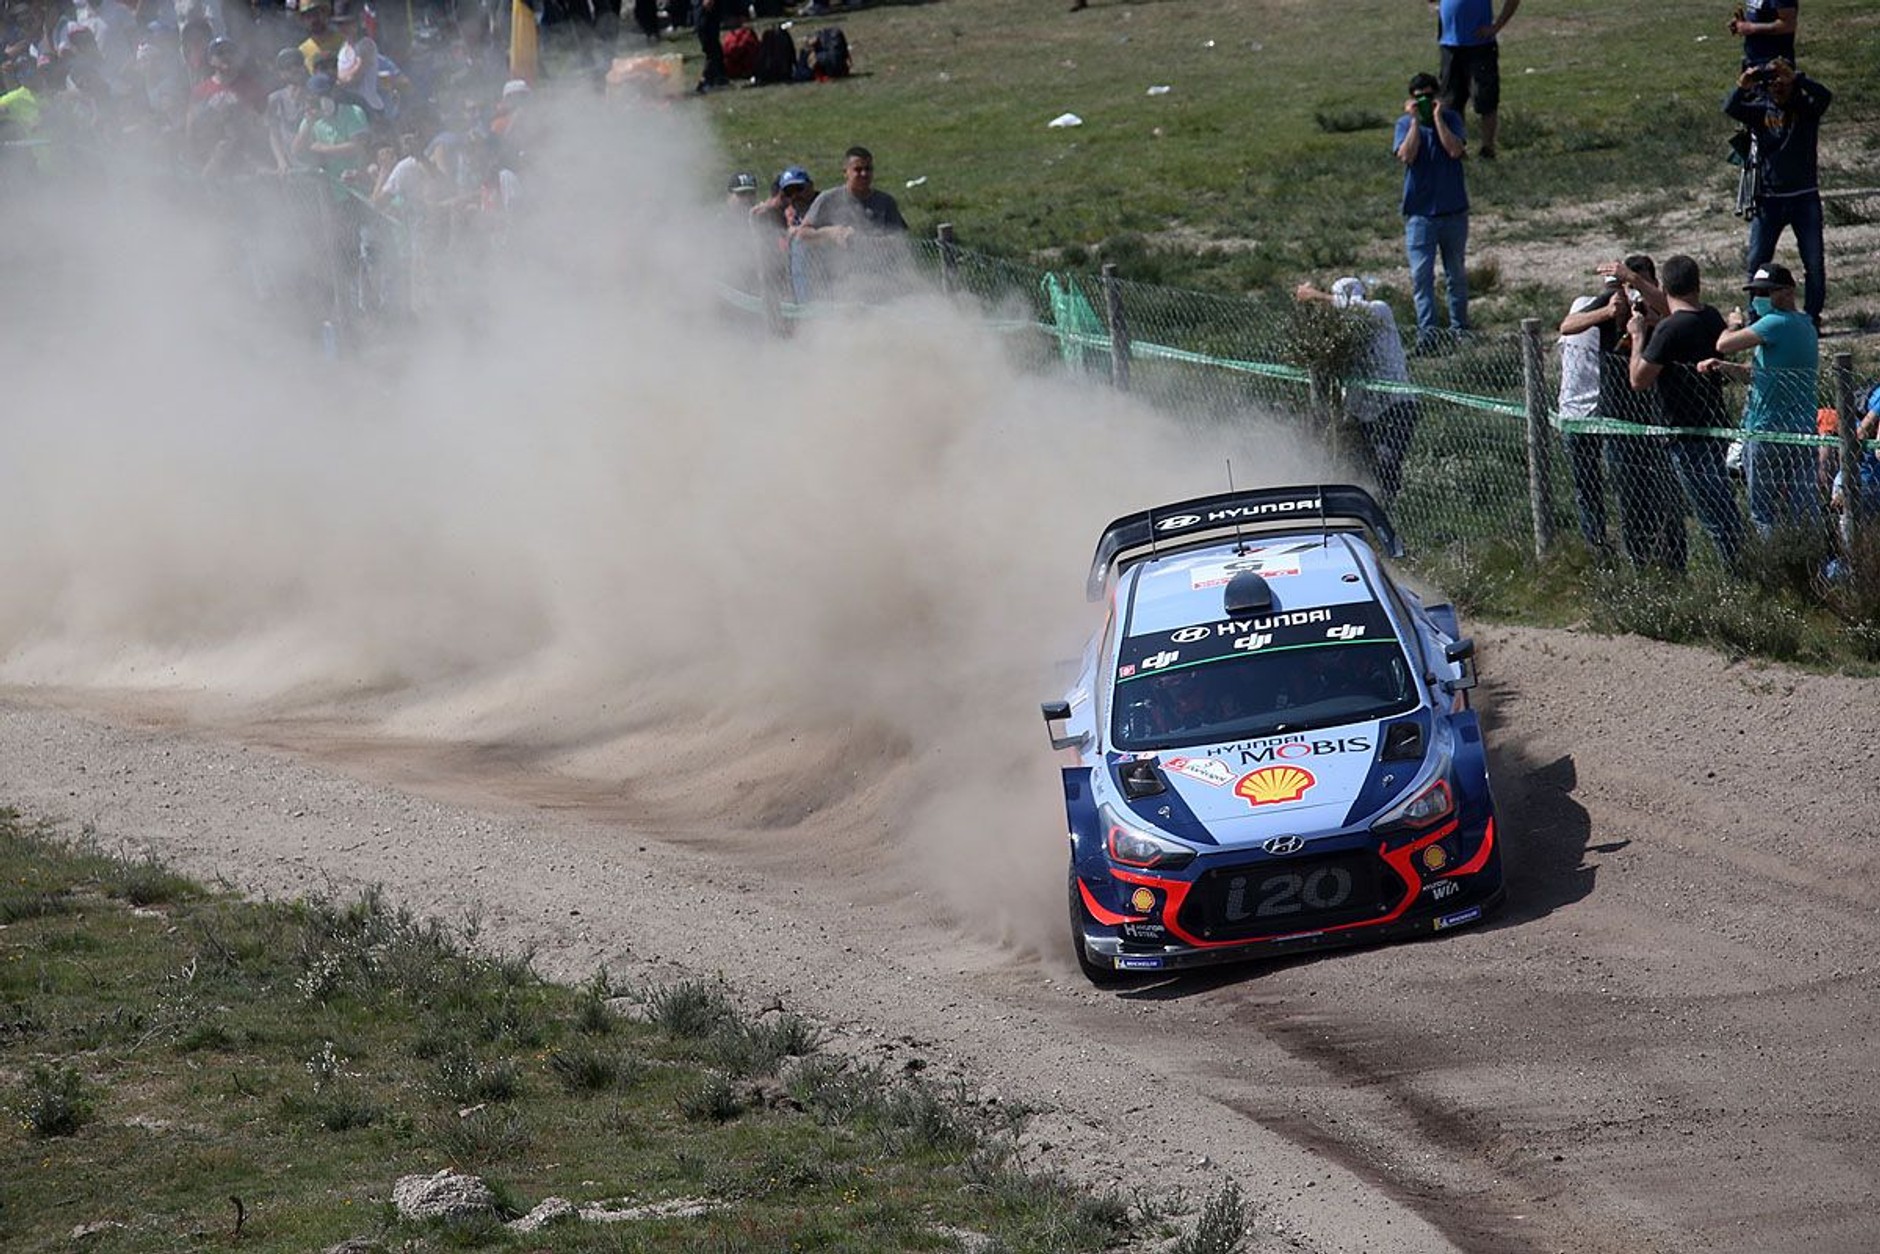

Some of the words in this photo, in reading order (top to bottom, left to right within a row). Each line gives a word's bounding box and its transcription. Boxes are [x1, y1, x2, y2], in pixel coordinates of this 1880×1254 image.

[1208, 498, 1322, 520] HYUNDAI
[1217, 609, 1332, 636] HYUNDAI
[1207, 735, 1305, 757] HYUNDAI
[1240, 736, 1371, 766] MOBIS
[1225, 867, 1351, 921] i20
[1432, 882, 1460, 900] WIA
